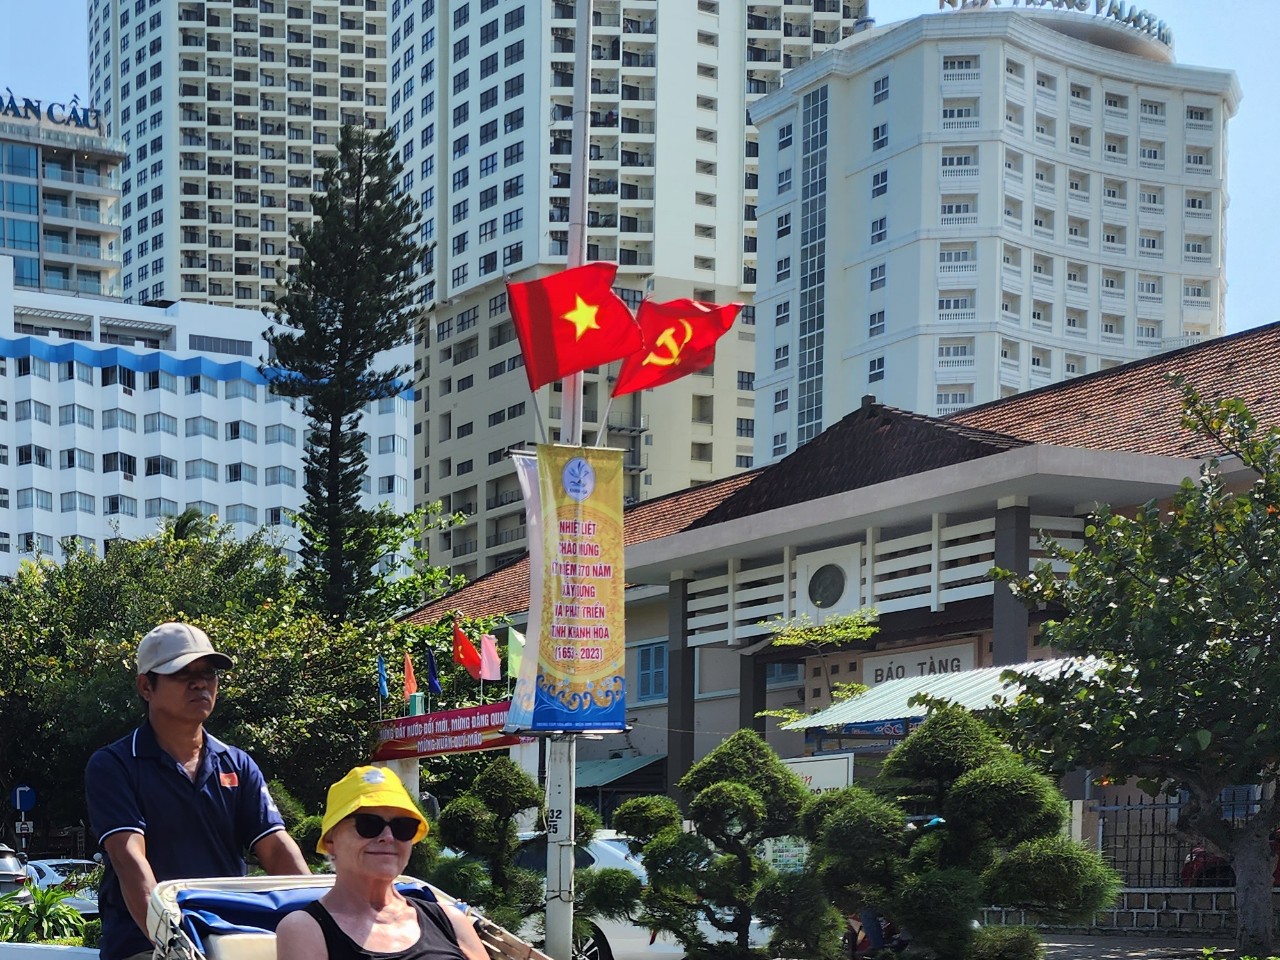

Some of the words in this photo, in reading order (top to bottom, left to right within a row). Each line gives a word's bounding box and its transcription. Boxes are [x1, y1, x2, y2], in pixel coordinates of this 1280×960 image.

[46, 93, 101, 130] CẦU
[581, 520, 597, 538] LIỆT
[558, 540, 577, 555] HÀO
[592, 563, 611, 578] NĂM
[582, 602, 605, 619] TRIỂN
[580, 647, 603, 660] 2023)
[916, 655, 961, 677] TÀNG
[451, 714, 471, 731] MỪNG
[471, 711, 490, 729] ĐẢNG
[490, 710, 509, 726] QUAN
[549, 808, 562, 820] 32
[547, 823, 558, 834] 25
